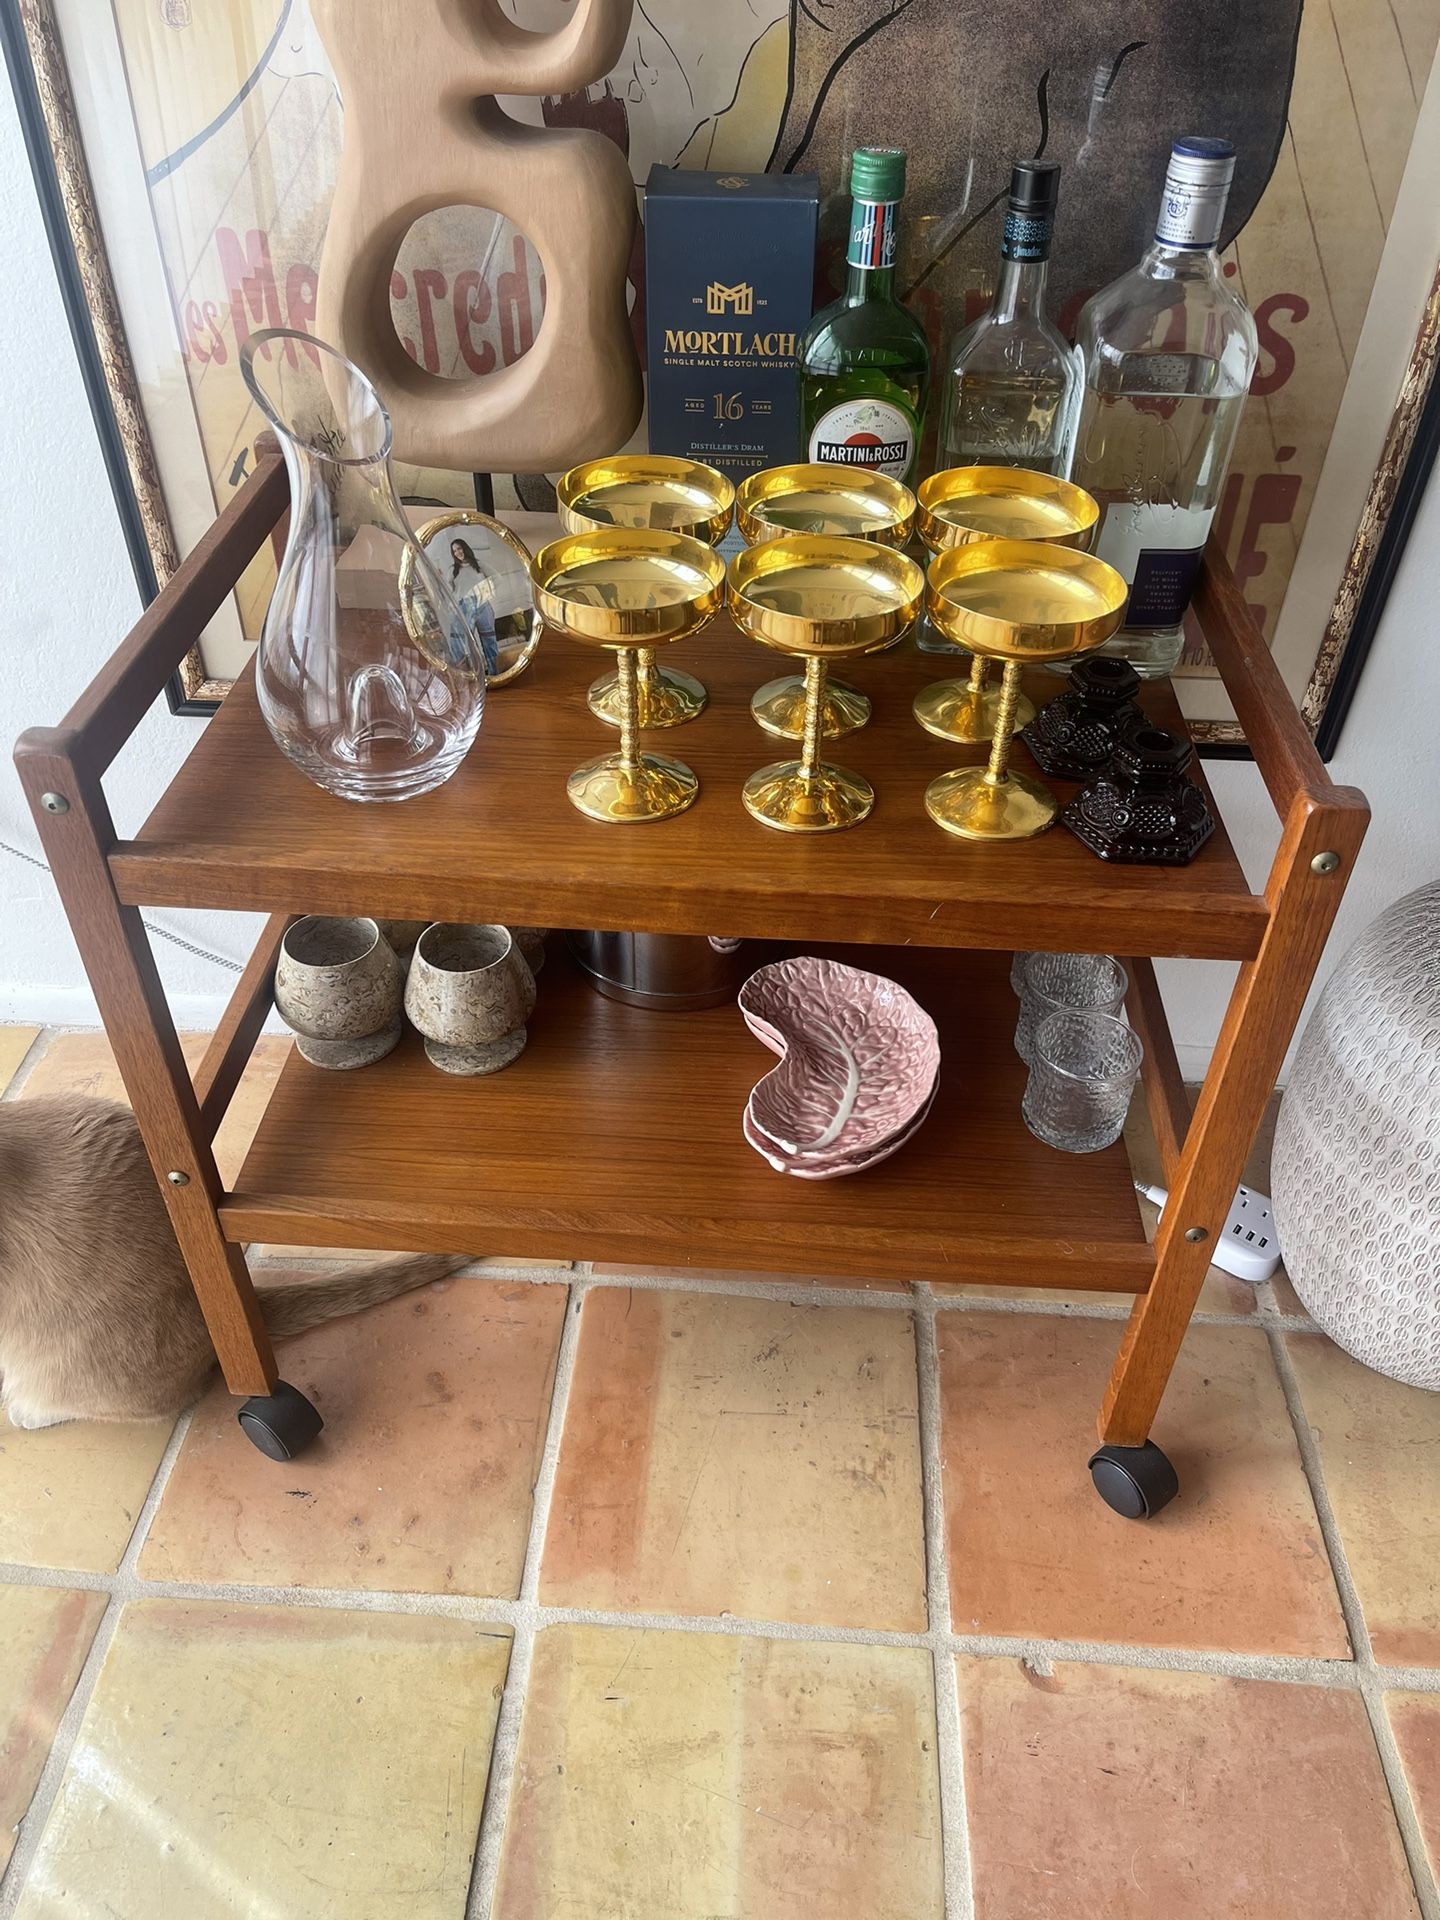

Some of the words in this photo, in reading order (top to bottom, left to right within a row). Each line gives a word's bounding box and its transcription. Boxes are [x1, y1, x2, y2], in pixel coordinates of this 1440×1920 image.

[663, 329, 797, 357] MORTLACH
[664, 357, 695, 366] SINGLE
[697, 359, 721, 367] MALT
[723, 360, 758, 368] SCOTCH
[760, 361, 795, 369] WHISKY
[712, 391, 745, 420] 16
[740, 444, 764, 452] DRAM
[715, 459, 763, 467] DISTILLED
